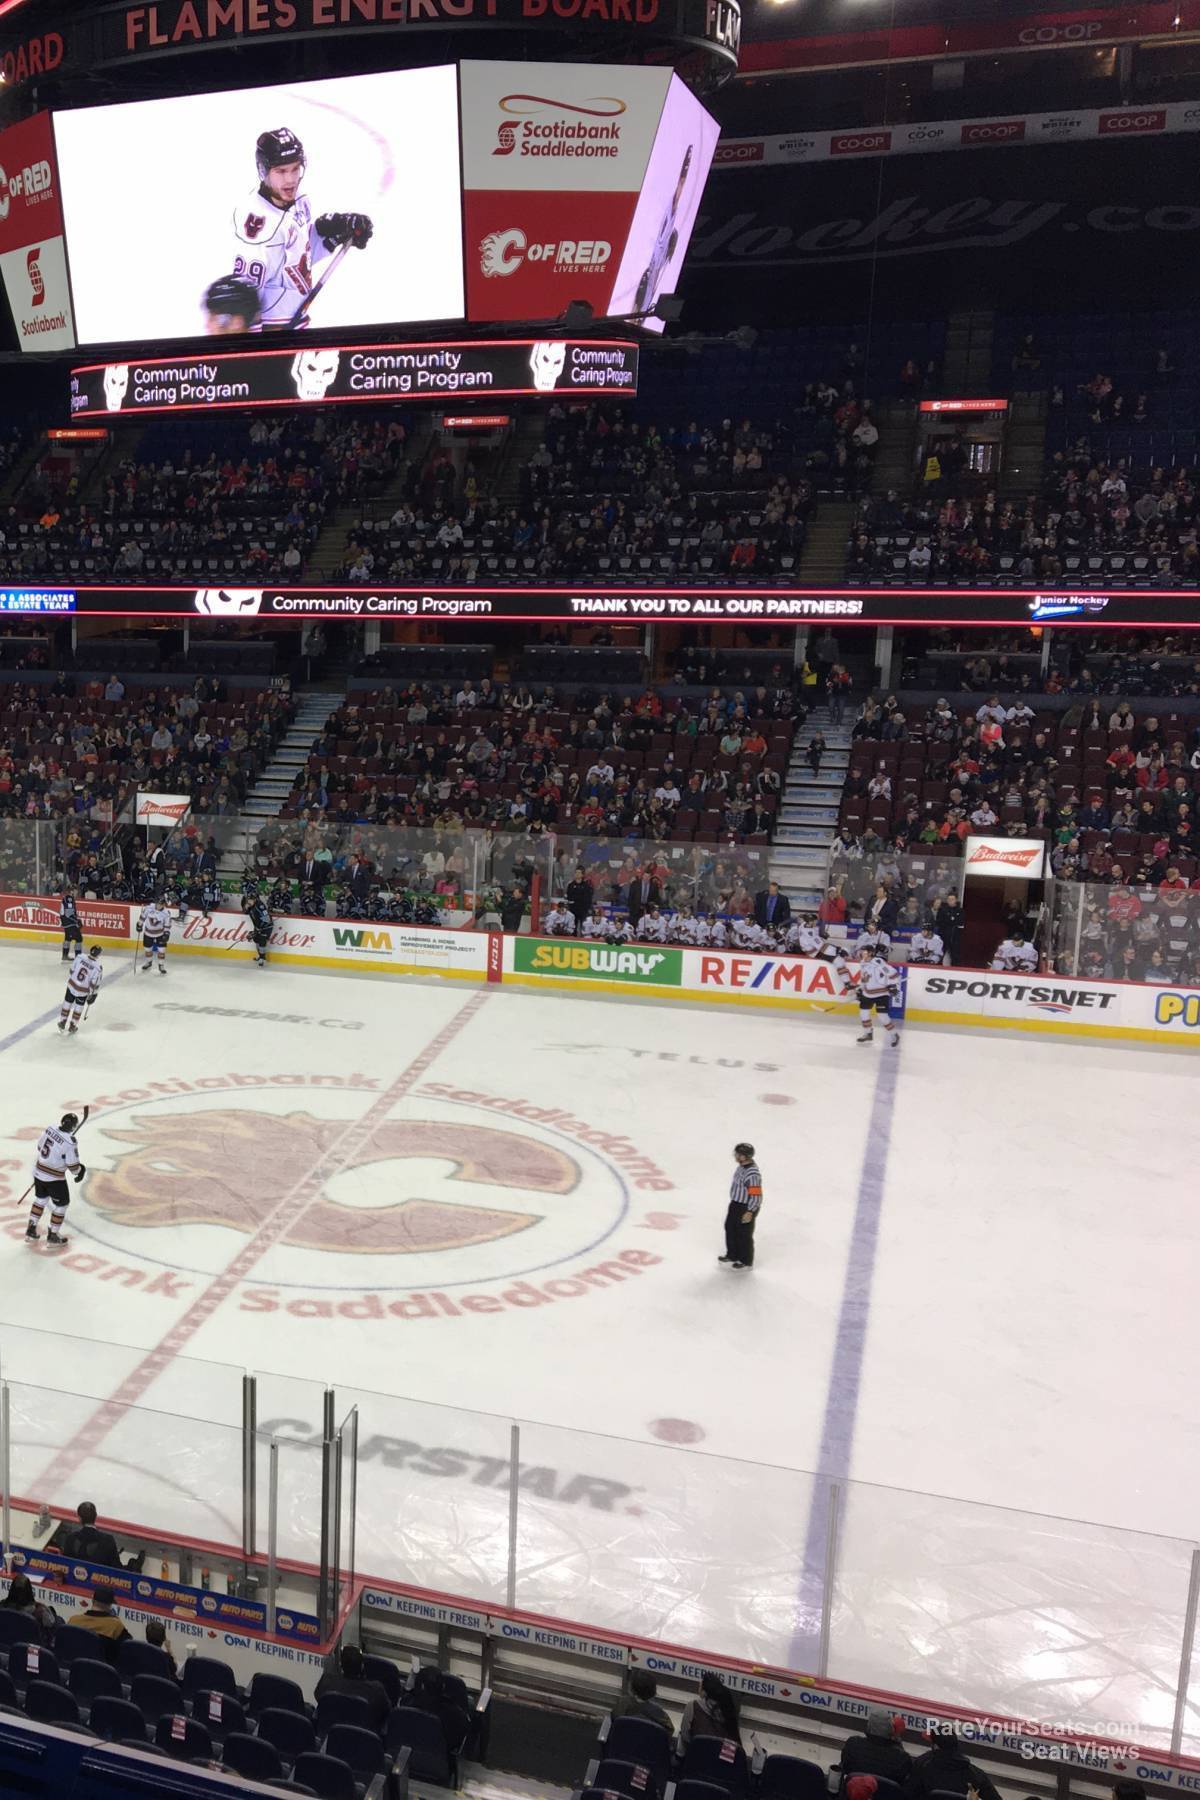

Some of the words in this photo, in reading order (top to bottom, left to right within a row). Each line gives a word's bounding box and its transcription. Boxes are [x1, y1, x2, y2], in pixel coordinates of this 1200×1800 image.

[523, 120, 620, 140] Scotiabank
[520, 141, 618, 158] Saddledome
[9, 174, 24, 197] OF
[24, 159, 52, 193] RED
[25, 194, 40, 208] LIVES
[40, 188, 54, 203] HERE
[527, 242, 555, 261] OF
[556, 240, 612, 265] RED
[553, 265, 579, 273] LIVES
[582, 265, 606, 273] HERE
[21, 310, 67, 336] Scotiabank
[351, 350, 461, 371] Community
[571, 348, 625, 366] Community
[134, 363, 218, 385] Community
[351, 373, 412, 392] Caring
[417, 369, 493, 388] Program
[571, 367, 606, 386] Caring
[134, 385, 177, 403] Caring
[181, 380, 249, 402] Program
[8, 601, 41, 610] ESTATE
[43, 602, 69, 610] TEAM
[18, 593, 75, 602] ASSOCIATES
[272, 596, 364, 614] Community
[367, 596, 417, 615] Caring
[422, 597, 492, 615] Program
[571, 598, 628, 613] THANK
[630, 599, 665, 613] YOU
[668, 599, 691, 613] TO
[693, 599, 725, 613] ALL
[726, 600, 763, 614] OUR
[766, 600, 863, 615] PARTNERS!
[1029, 595, 1068, 610] Junior
[1070, 595, 1109, 607] Hockey
[141, 803, 185, 815] Budweiser
[972, 846, 1036, 863] Budweiser
[6, 908, 29, 923] PAPA
[30, 909, 61, 926] JOHNS
[98, 918, 125, 930] PIZZA.
[182, 915, 316, 947] Budiser
[531, 945, 666, 975] SUBWAY
[77, 967, 88, 982] 6
[925, 977, 1117, 1009] SPORTSNET
[628, 1049, 782, 1072] TELUS
[61, 1072, 380, 1112] Scotiabank
[417, 1082, 678, 1193] Saddledome
[41, 1138, 54, 1160] 5
[240, 1247, 663, 1320] Saddledome
[396, 1599, 436, 1620] KEEPING
[438, 1607, 447, 1622] IT
[449, 1610, 481, 1628] FRESH
[255, 1641, 294, 1661] KEEPING
[296, 1651, 306, 1663] IT
[502, 1624, 531, 1639] OPA!
[534, 1631, 576, 1651] KEEPING
[578, 1641, 589, 1653] IT
[591, 1643, 624, 1661] FRESH
[646, 1656, 678, 1672] OPA!
[800, 1691, 833, 1708] OPA!
[837, 1699, 870, 1717] KEEPI
[1136, 1765, 1173, 1782] OPA!
